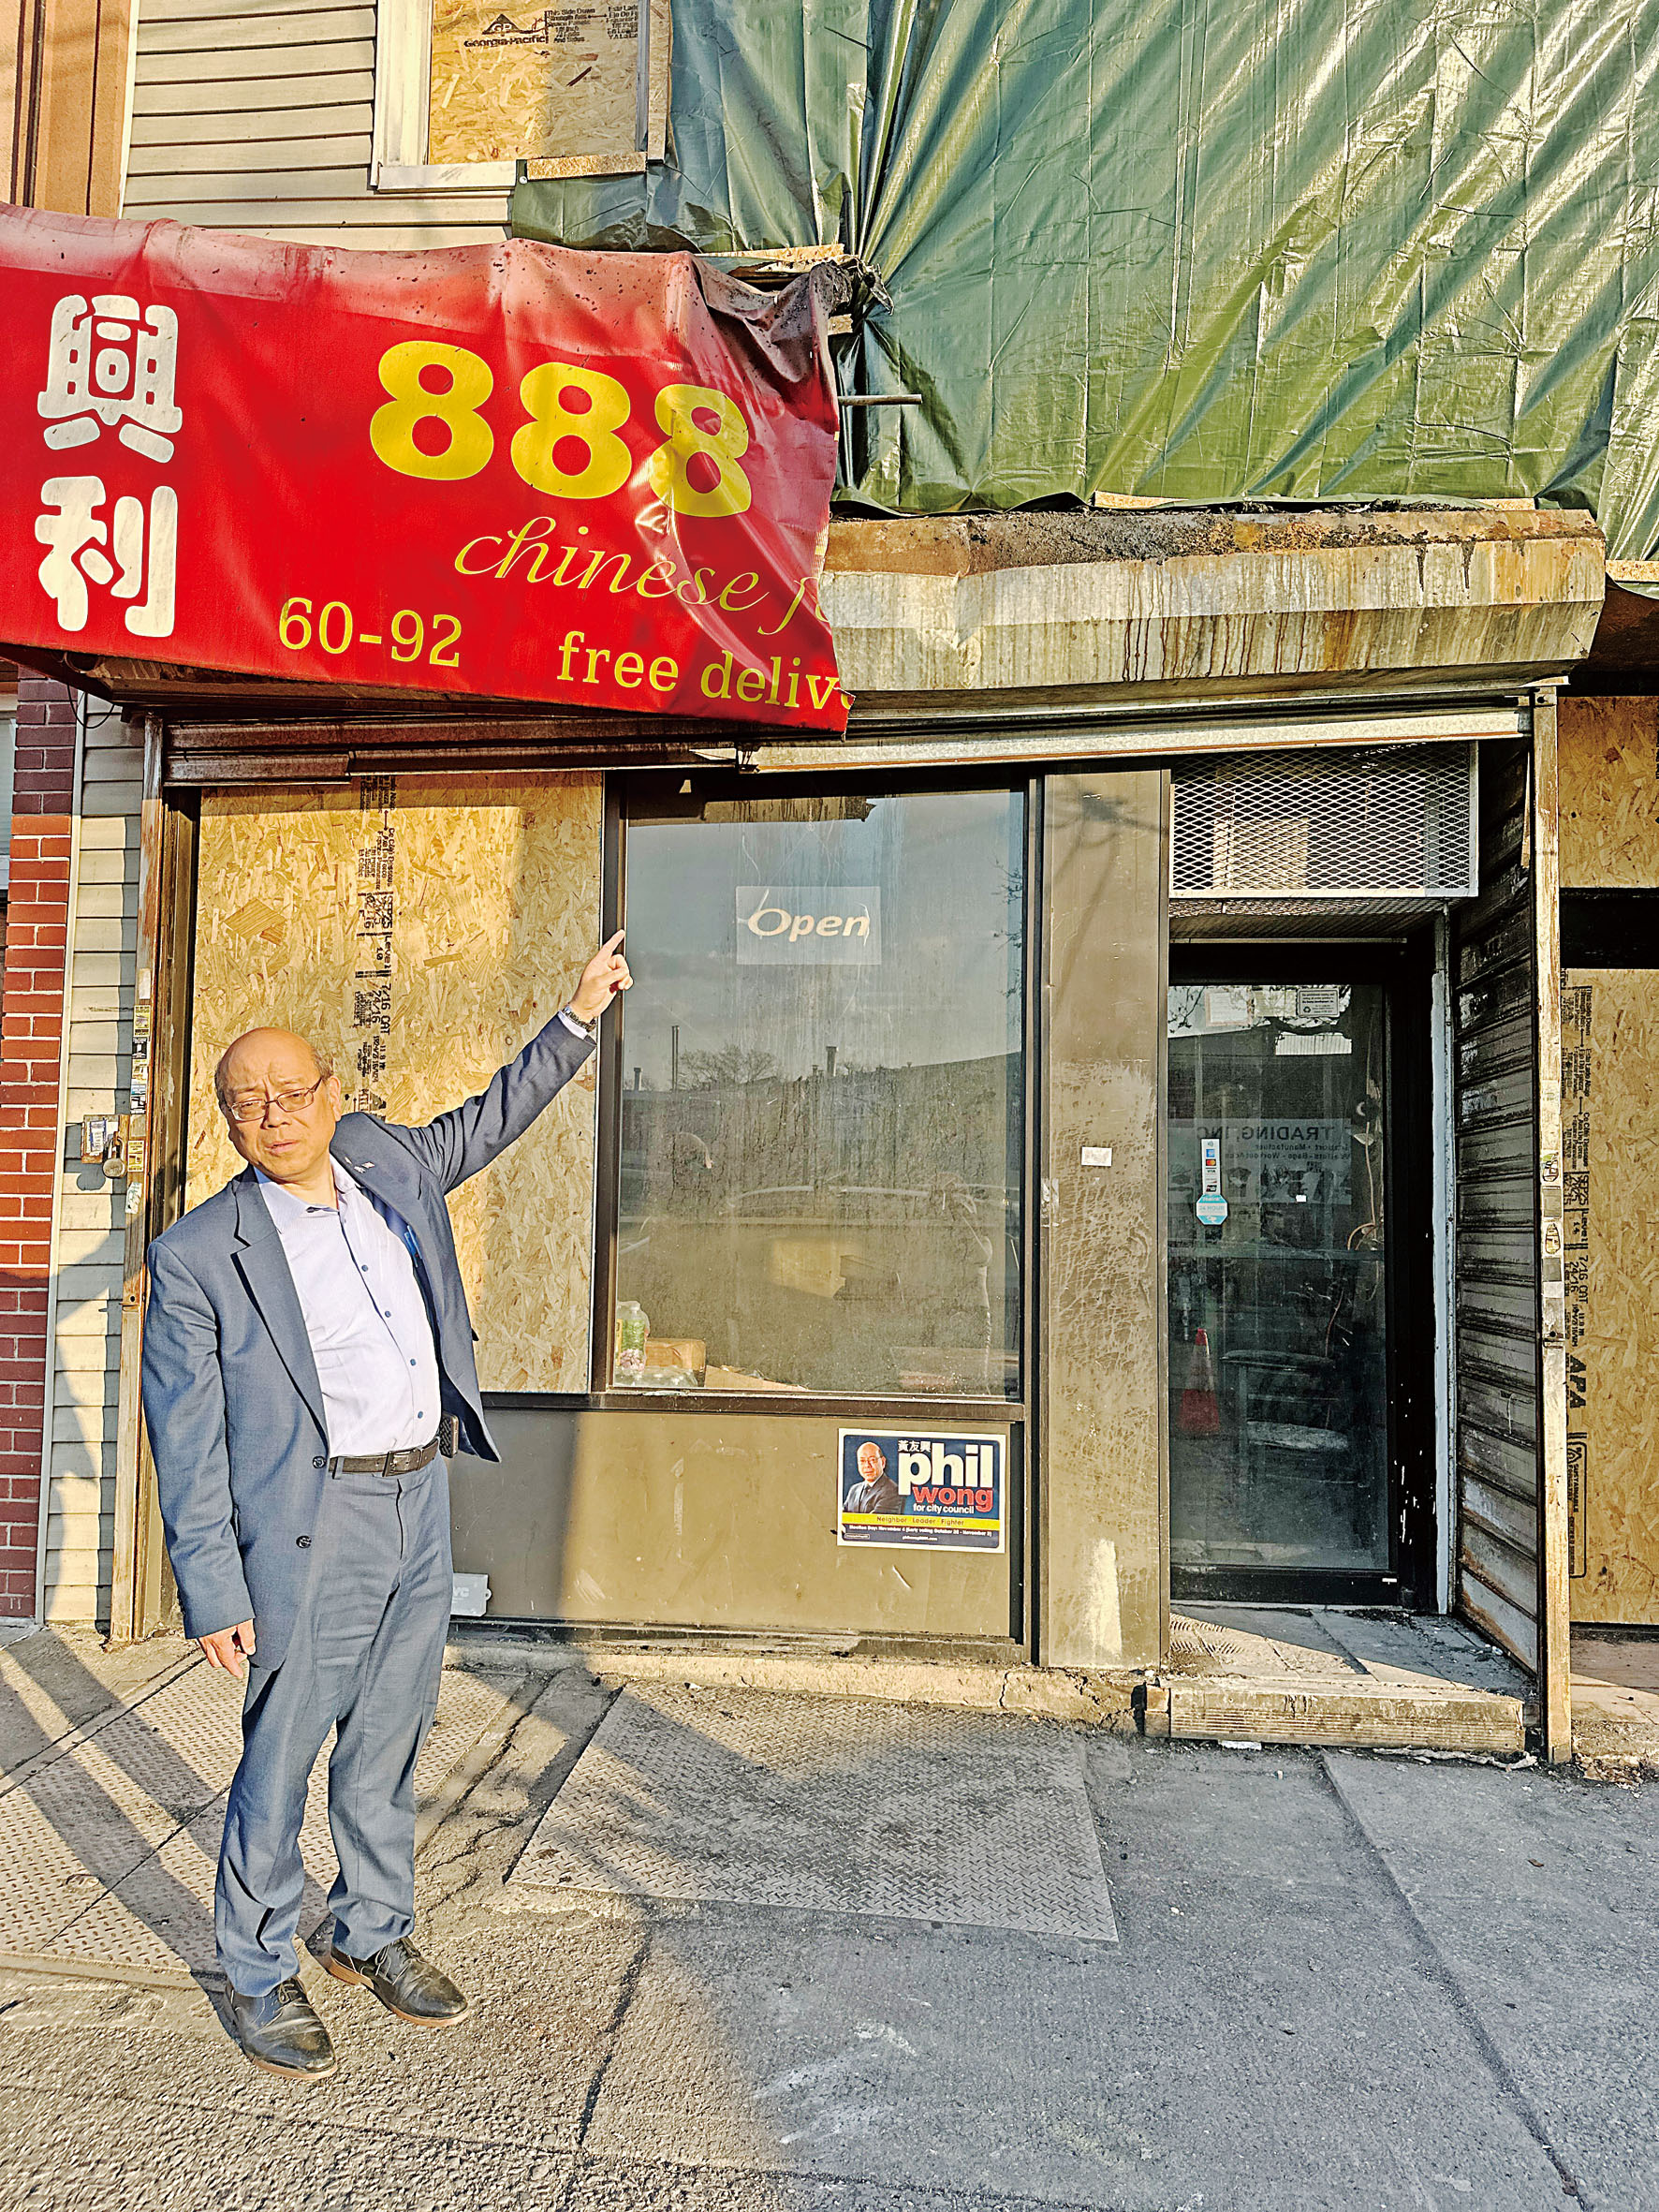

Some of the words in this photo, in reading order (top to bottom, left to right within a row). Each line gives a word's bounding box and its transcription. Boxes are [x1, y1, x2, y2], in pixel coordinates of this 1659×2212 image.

[464, 36, 545, 47] Georgia-Pacific
[369, 340, 752, 518] 888
[36, 293, 183, 638] 興利
[455, 514, 771, 612] chinese
[757, 576, 830, 636] f
[279, 597, 462, 669] 60-92
[558, 630, 680, 692] free
[748, 908, 870, 942] Open
[372, 990, 381, 1024] 24/16
[382, 983, 391, 1010] 7/16
[380, 1015, 390, 1035] CAT
[1578, 1175, 1589, 1205] SEP25
[1570, 1261, 1578, 1292] 24/16
[1578, 1256, 1588, 1281] 7/16
[1579, 1285, 1588, 1304] CAT
[1570, 1355, 1587, 1409] APA
[898, 1443, 993, 1496] phil
[912, 1486, 993, 1512] wong
[913, 1503, 925, 1512] for
[926, 1504, 942, 1513] city
[943, 1505, 974, 1513] council
